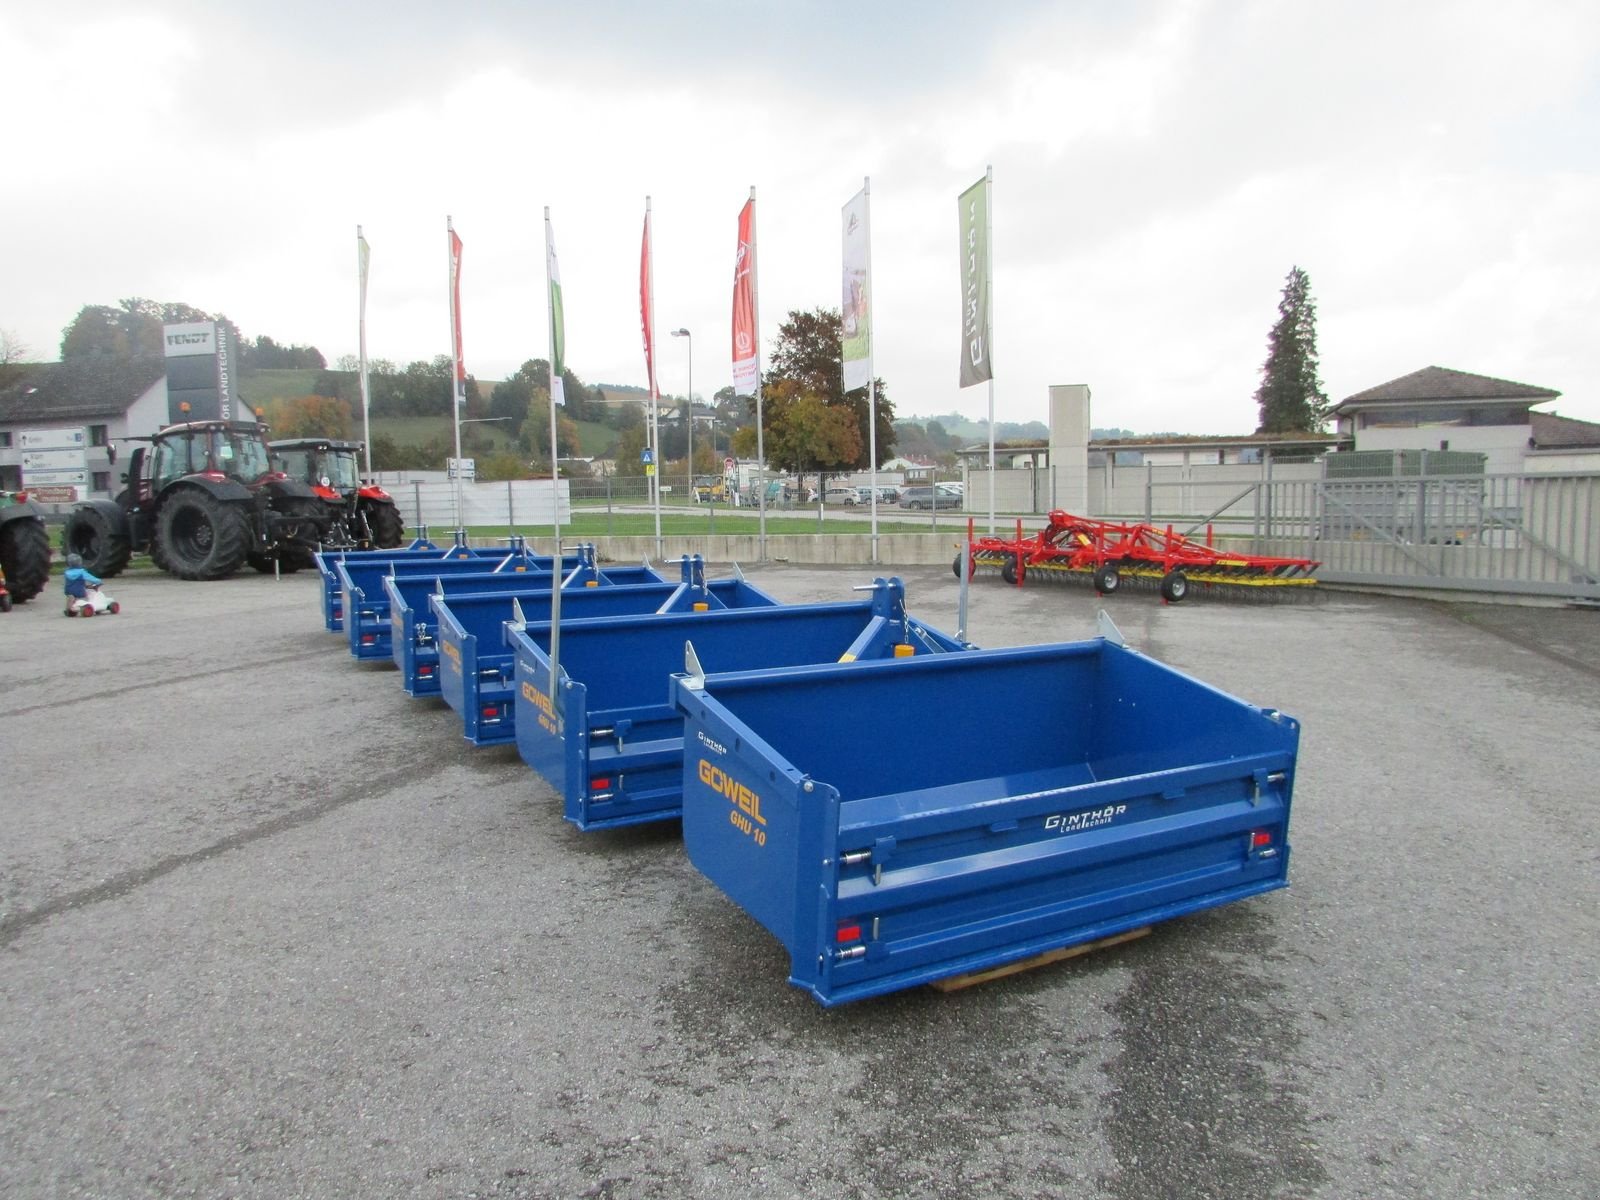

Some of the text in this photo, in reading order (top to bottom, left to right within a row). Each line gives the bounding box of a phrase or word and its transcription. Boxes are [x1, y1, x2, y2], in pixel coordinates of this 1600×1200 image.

[167, 332, 210, 346] FENDT
[218, 328, 230, 403] LANDTECHNIK
[730, 810, 766, 847] GHU 10
[1044, 805, 1126, 829] GINTHÖR
